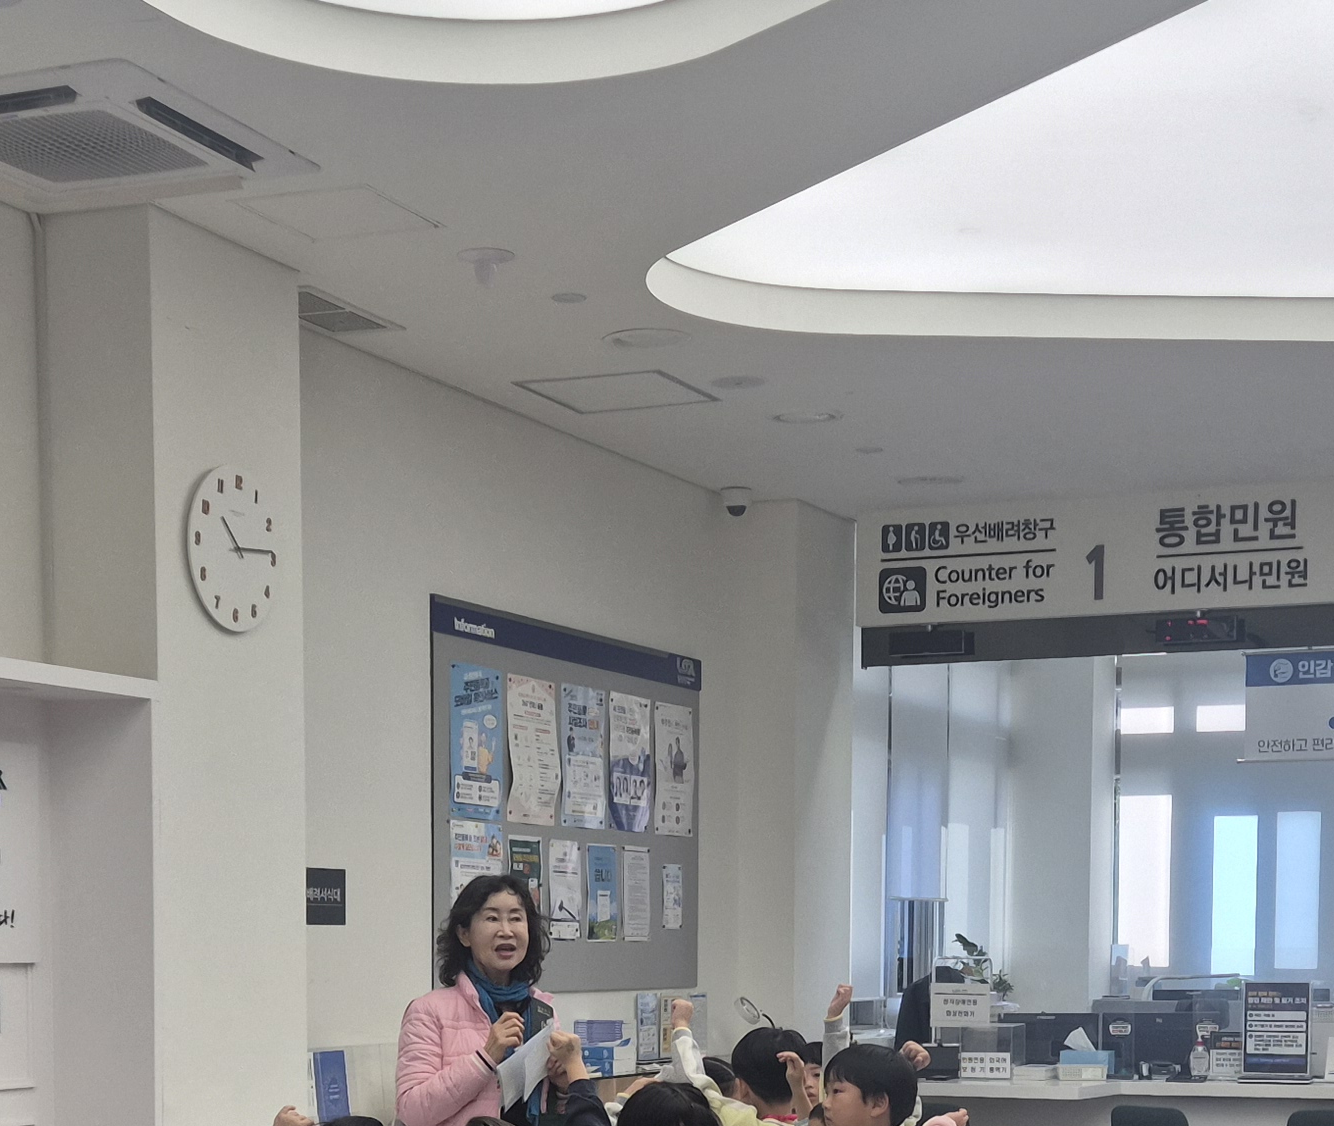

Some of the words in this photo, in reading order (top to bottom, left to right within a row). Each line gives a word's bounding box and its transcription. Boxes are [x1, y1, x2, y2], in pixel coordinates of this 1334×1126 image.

[953, 518, 1058, 545] 우선배려창구
[1155, 498, 1299, 546] 통합민원
[934, 563, 1024, 586] Counter
[1028, 558, 1056, 581] for
[1085, 545, 1105, 602] 1
[1153, 556, 1310, 596] 어디서나민원
[936, 583, 1046, 609] Foreigners
[1297, 658, 1334, 679] 인감
[1257, 737, 1308, 754] 안전하고
